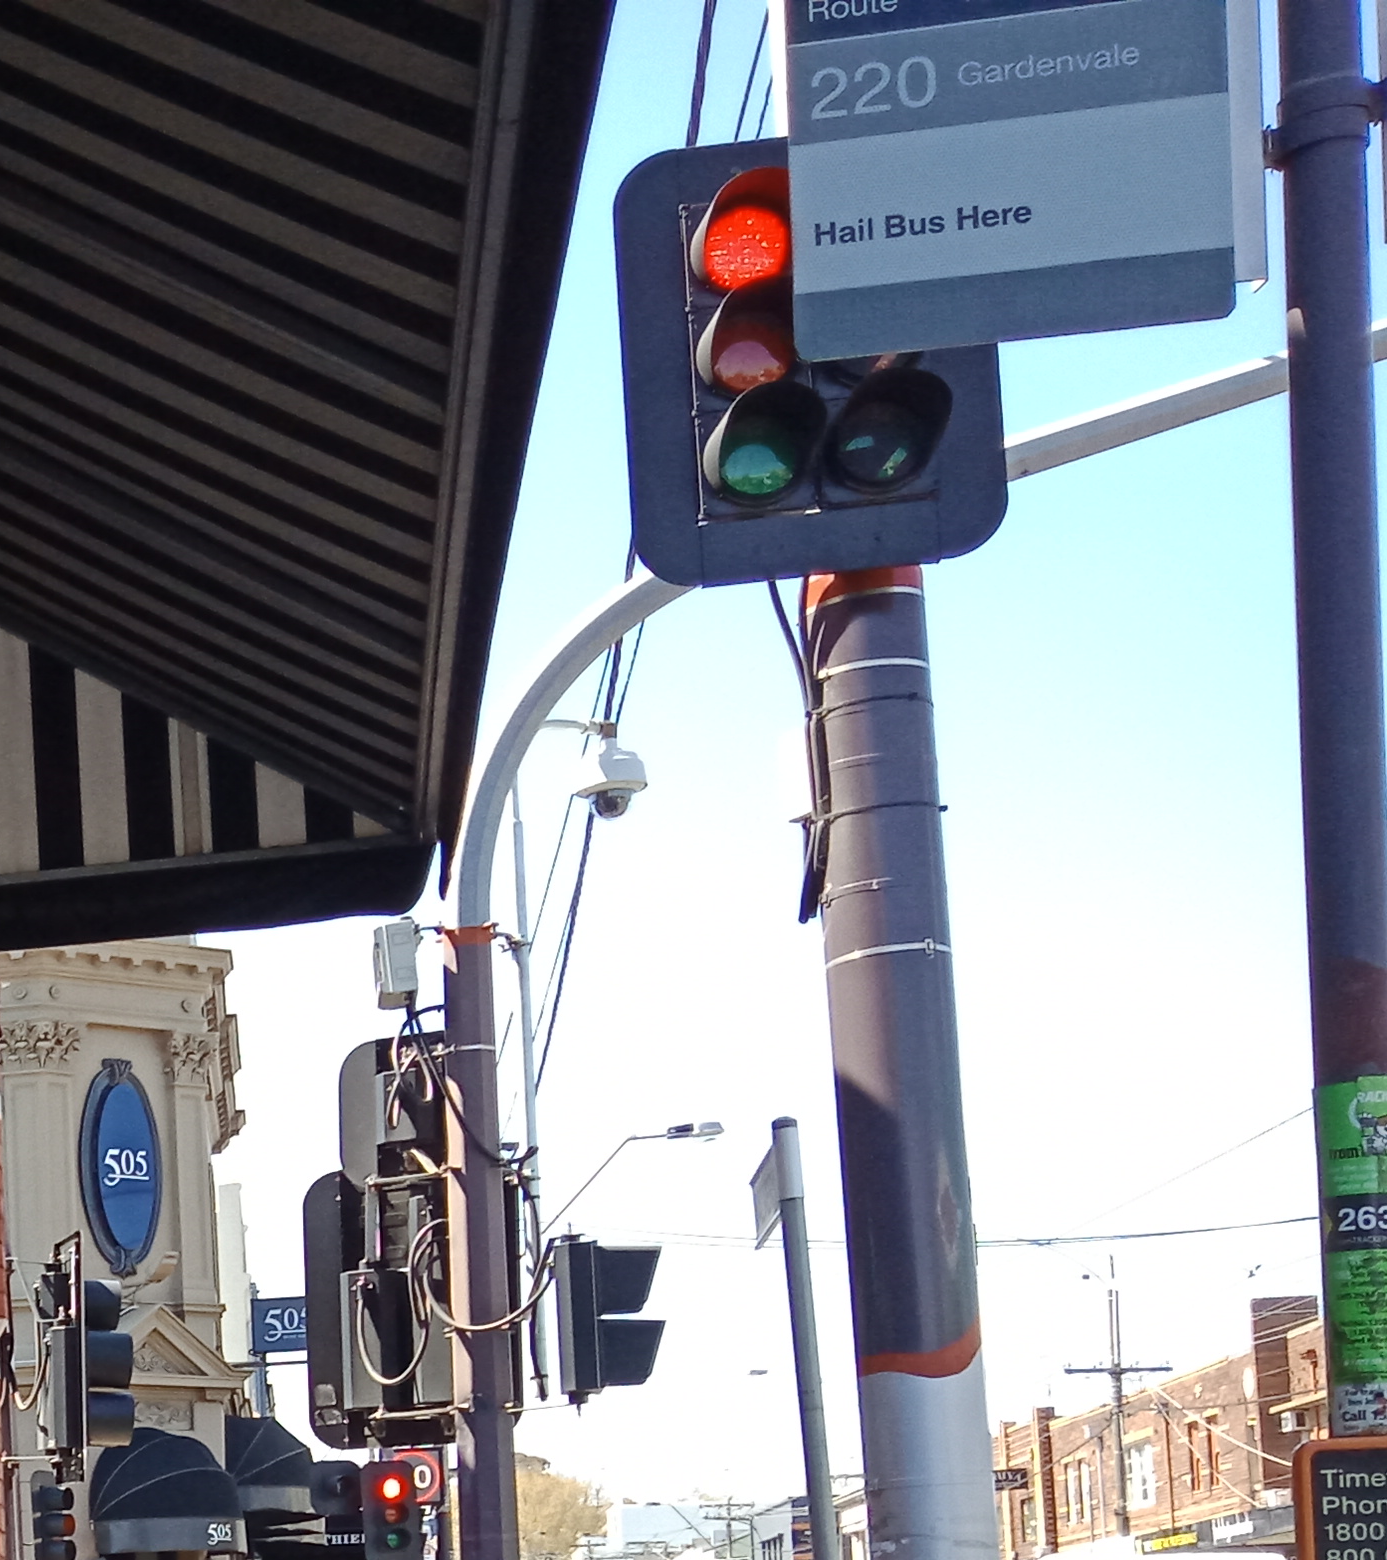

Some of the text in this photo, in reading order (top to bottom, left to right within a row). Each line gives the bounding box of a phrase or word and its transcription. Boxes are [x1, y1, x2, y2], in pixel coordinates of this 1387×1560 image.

[811, 43, 1141, 121] 220 Gardenvale
[814, 204, 1033, 247] Hail Bus Here
[103, 1148, 149, 1186] 505
[414, 1465, 432, 1489] 0
[1320, 1469, 1387, 1489] Time
[207, 1523, 232, 1546] 505
[1324, 1522, 1385, 1541] 1800
